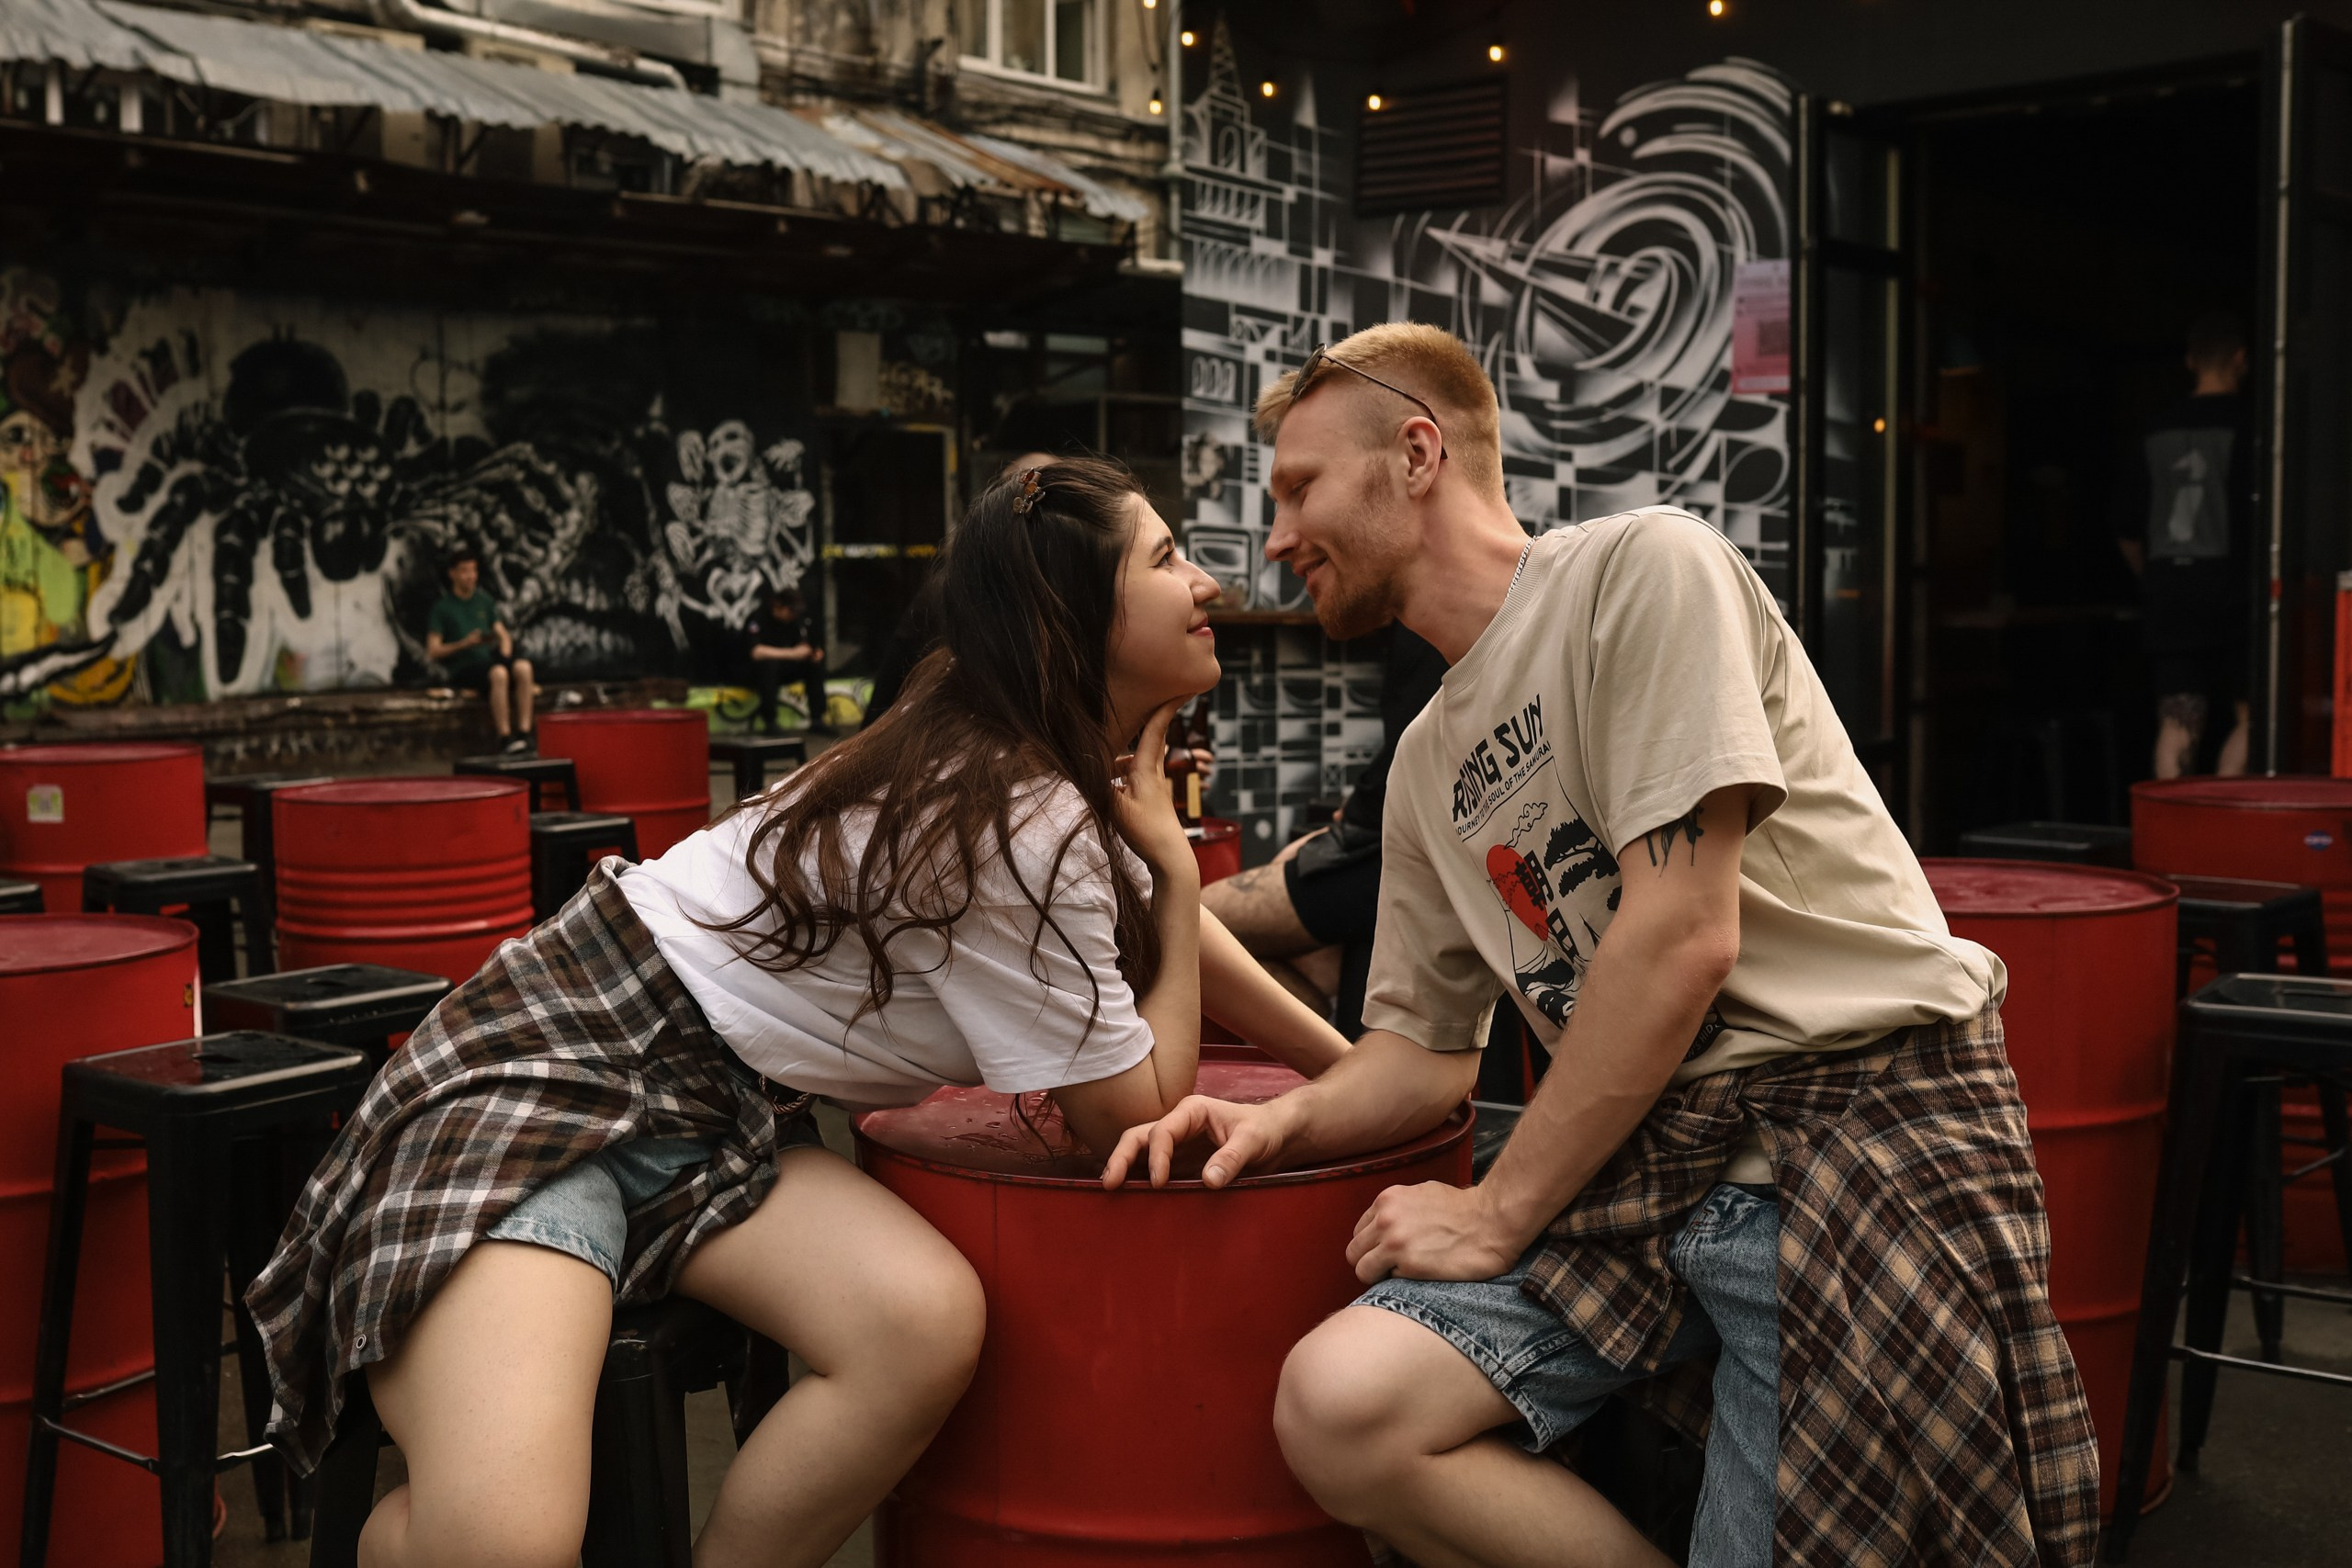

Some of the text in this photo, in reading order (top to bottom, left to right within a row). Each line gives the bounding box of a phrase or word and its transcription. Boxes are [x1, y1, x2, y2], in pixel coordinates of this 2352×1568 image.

[1453, 694, 1544, 822] RISING SUN
[1487, 786, 1505, 806] SOUL
[1505, 777, 1514, 791] OF
[1514, 766, 1526, 784] THE
[1525, 740, 1552, 773] SAMURAI
[1515, 850, 1579, 963] 朝日
